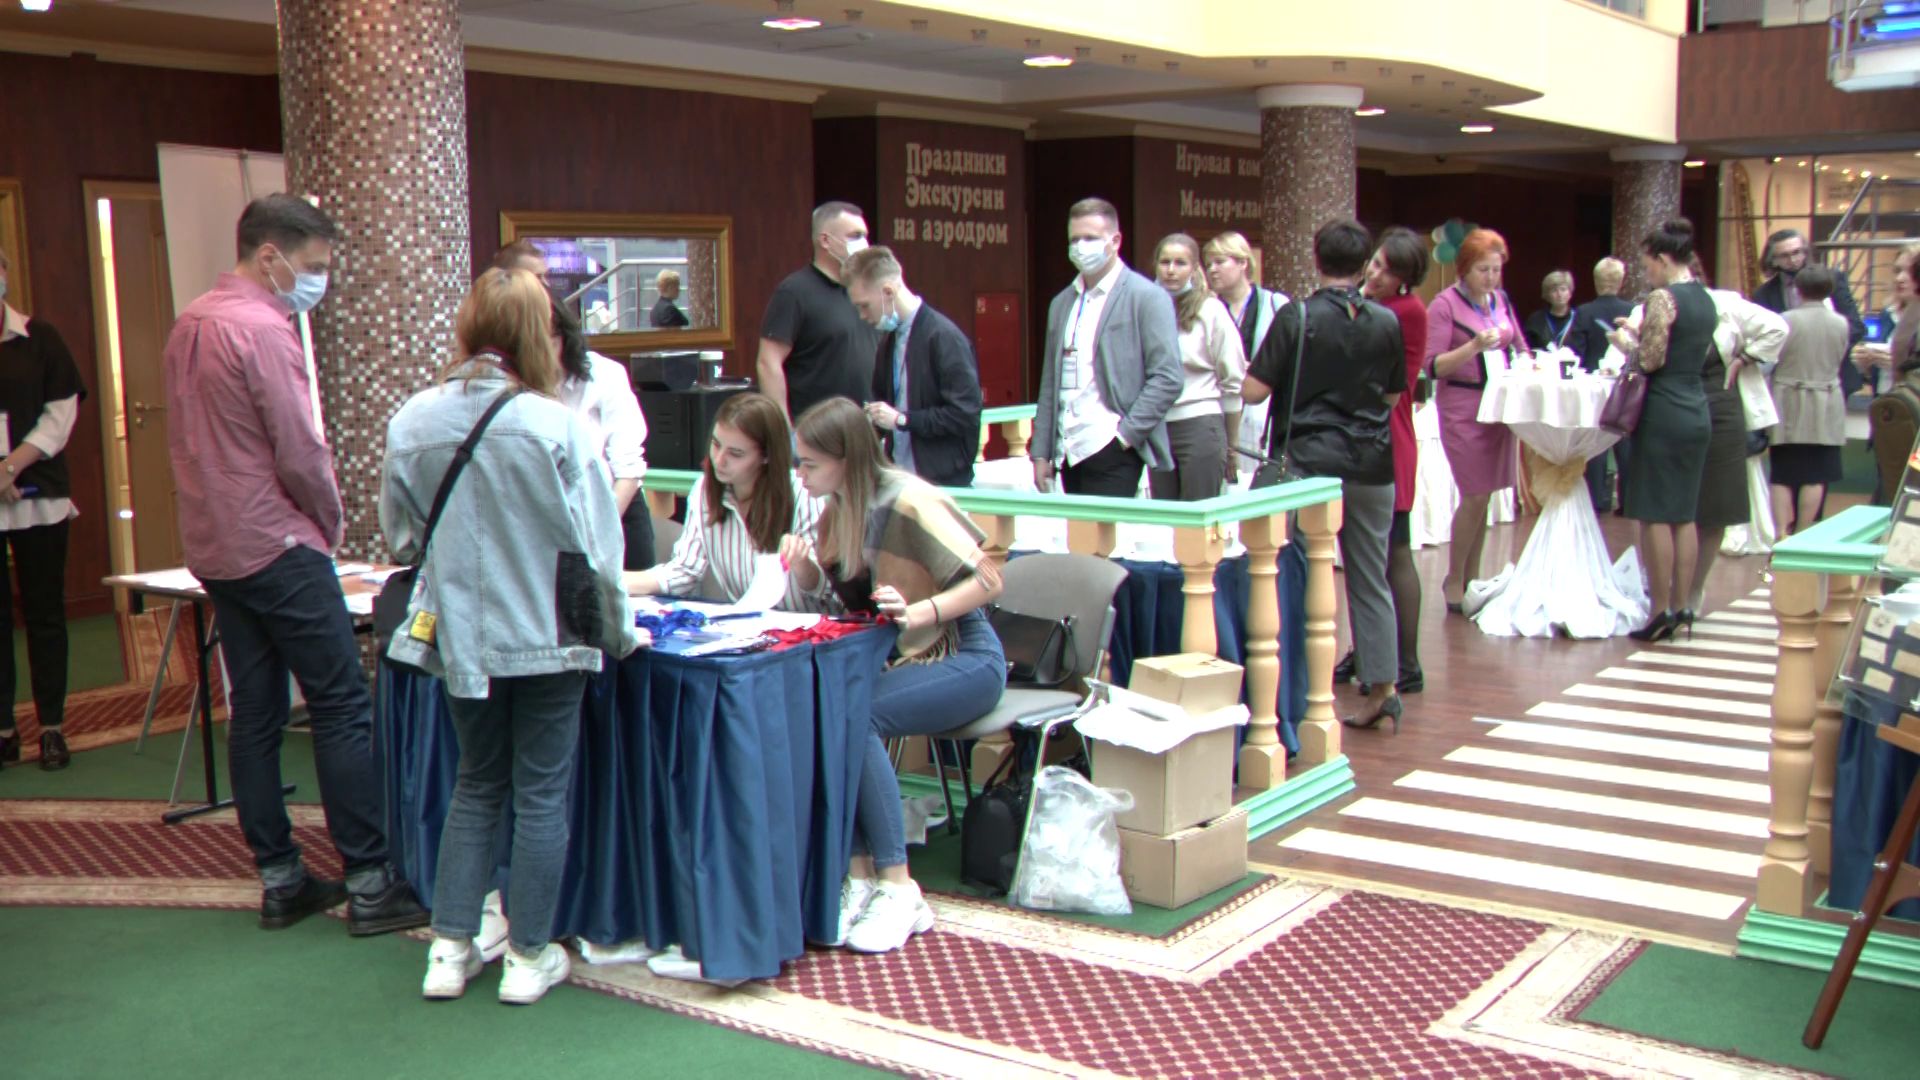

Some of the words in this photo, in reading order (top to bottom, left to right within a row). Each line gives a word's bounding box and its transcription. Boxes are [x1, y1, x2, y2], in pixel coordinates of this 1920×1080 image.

[906, 143, 1006, 177] Праздники
[1176, 143, 1231, 178] Игровая
[1237, 158, 1262, 177] ком
[905, 175, 1005, 214] Экскурсии
[893, 217, 916, 241] на
[922, 218, 1009, 250] аэродром
